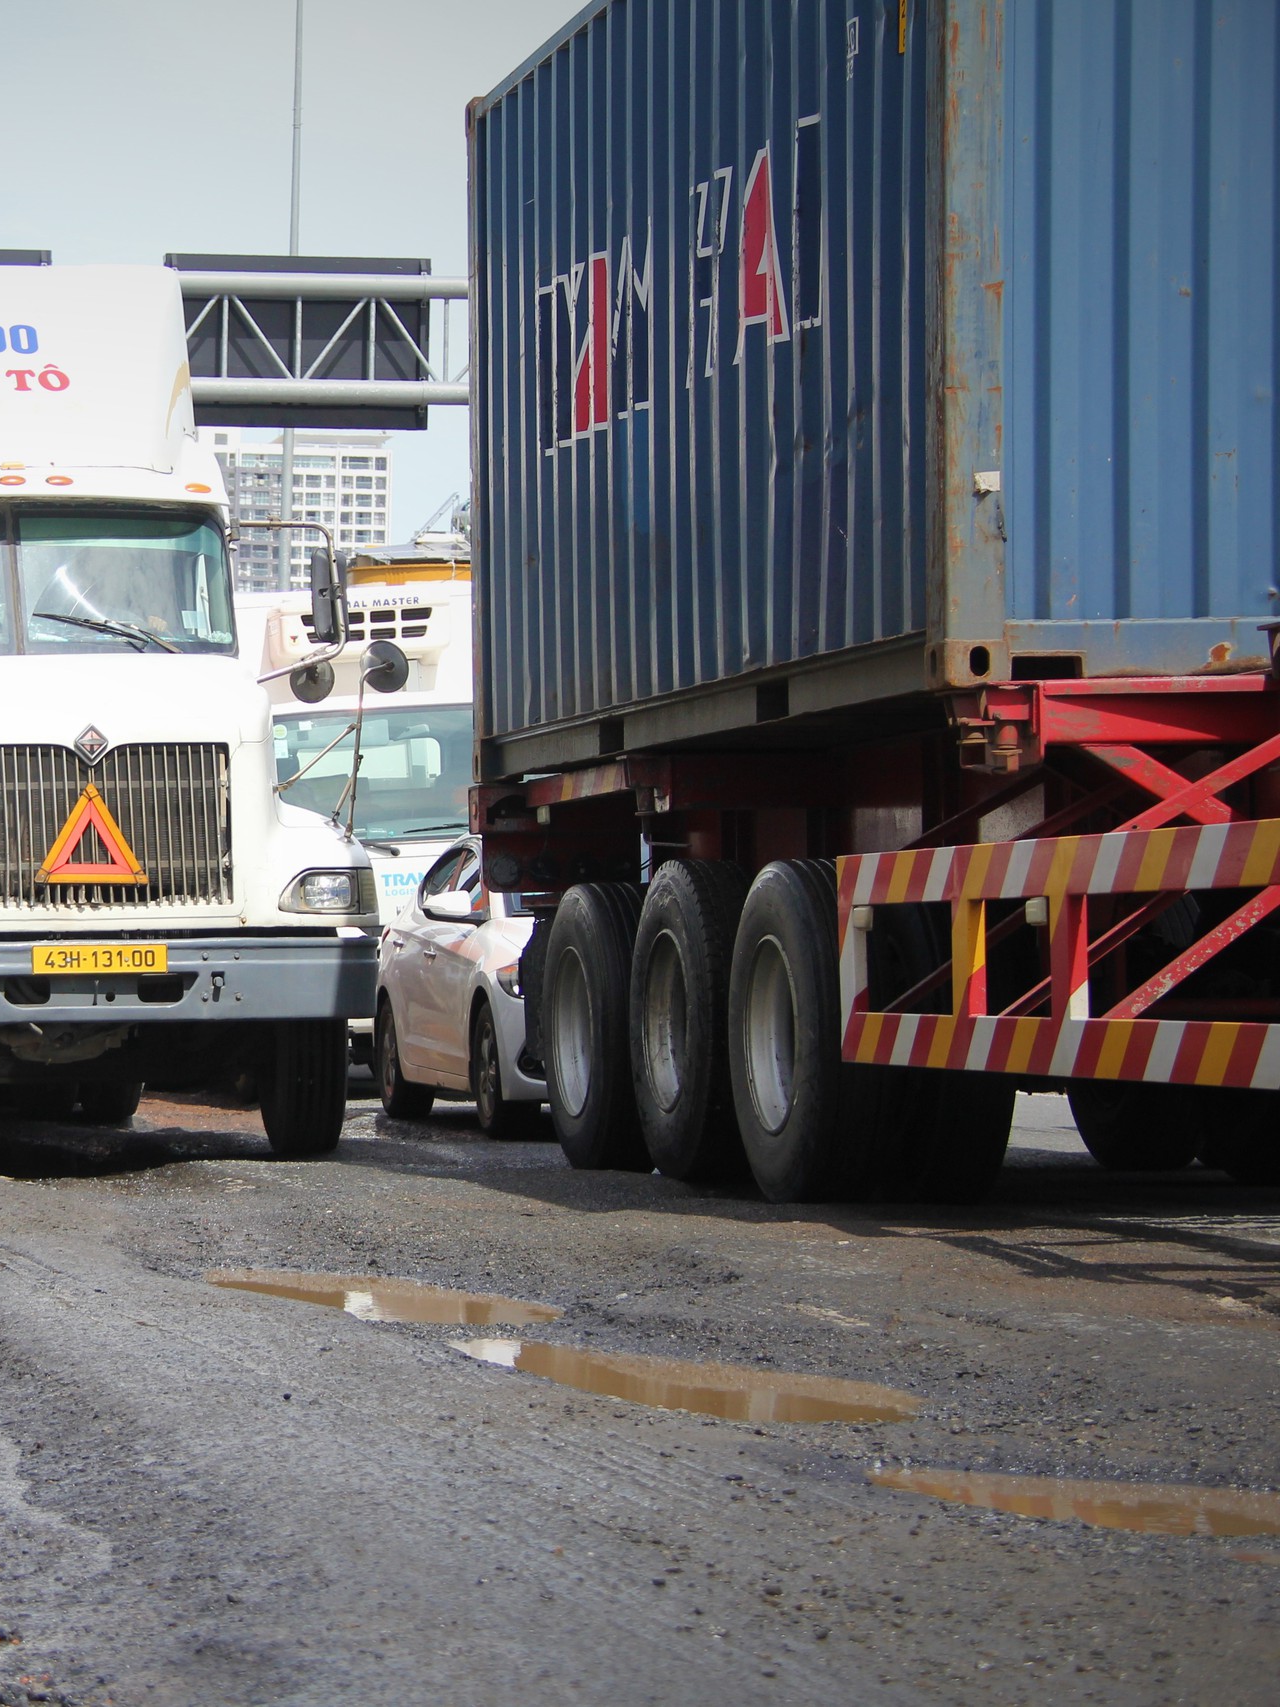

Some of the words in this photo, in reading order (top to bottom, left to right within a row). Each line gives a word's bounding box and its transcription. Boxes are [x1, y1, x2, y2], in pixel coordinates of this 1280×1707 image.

[5, 363, 70, 391] TÔ
[372, 596, 419, 607] MASTER
[45, 950, 155, 968] 43H-131.00
